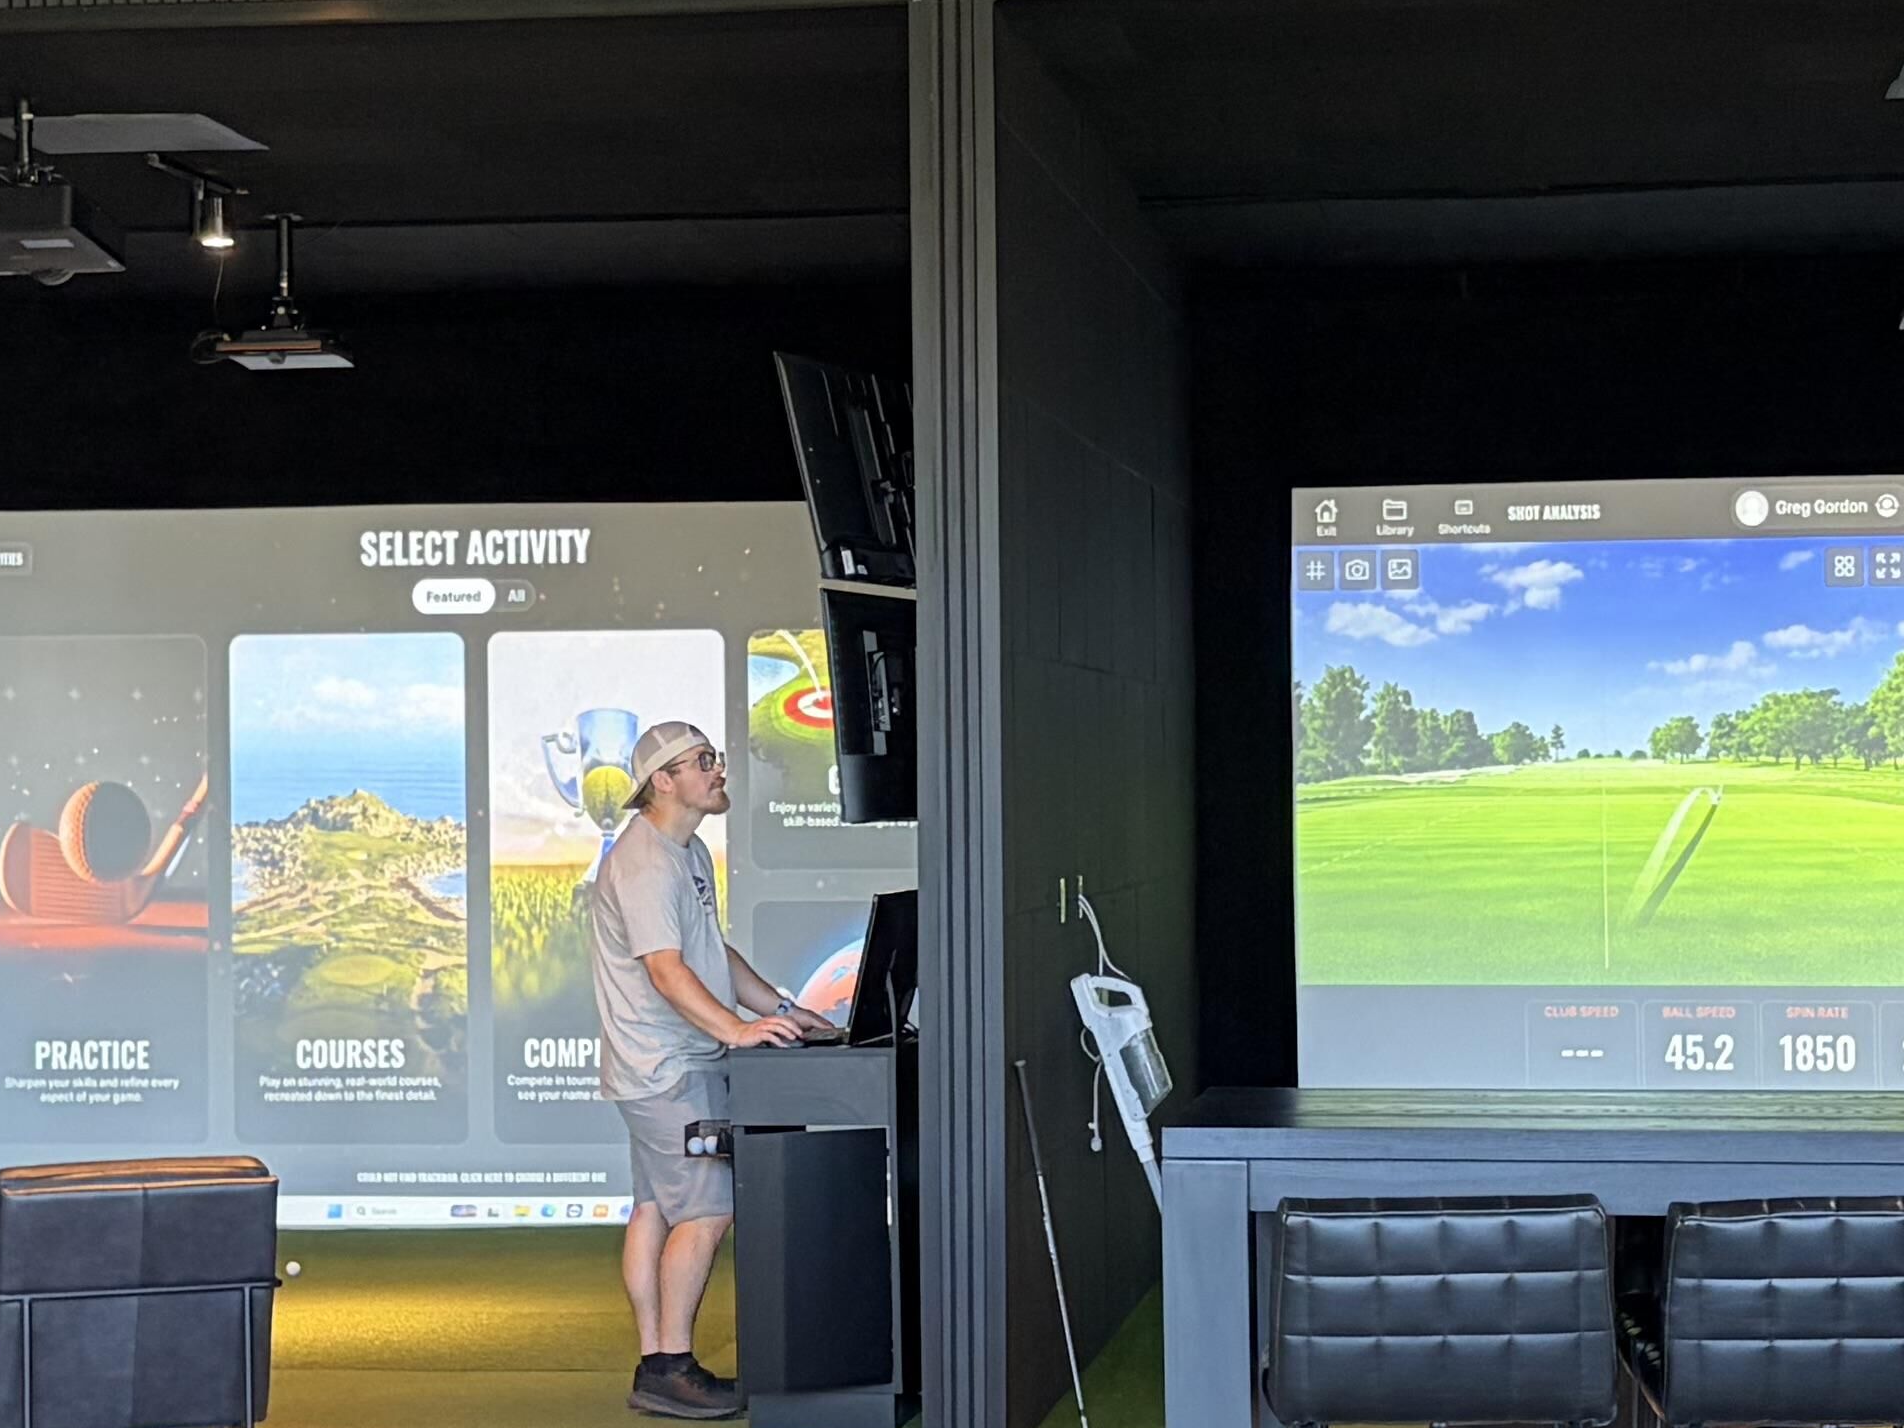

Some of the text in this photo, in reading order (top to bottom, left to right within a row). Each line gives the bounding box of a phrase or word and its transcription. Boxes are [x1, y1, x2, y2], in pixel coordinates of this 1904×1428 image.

[1507, 503, 1600, 522] SHOT ANALYSIS
[1775, 498, 1869, 518] Greg Gordon
[1316, 525, 1337, 537] Exit
[1376, 523, 1415, 537] Library
[1438, 523, 1491, 535] Shortcuts
[360, 528, 591, 567] SELECT ACTIVITY
[426, 590, 482, 603] Featured
[507, 589, 526, 603] All
[768, 801, 798, 815] Enjoy
[807, 801, 841, 815] variety
[1544, 1006, 1619, 1018] CLUB SPEED
[1662, 1006, 1736, 1019] BALL SPEED
[1785, 1006, 1848, 1019] SPIN RATE
[35, 1039, 151, 1070] PRACTICE
[296, 1038, 406, 1069] COURSES
[1664, 1034, 1735, 1072] 45.2
[1779, 1034, 1856, 1072] 1850
[48, 1078, 71, 1090] your
[151, 1078, 180, 1090] every
[259, 1075, 281, 1089] Play
[282, 1077, 296, 1087] on
[507, 1074, 601, 1088] Compete in tourna
[88, 1093, 111, 1104] your
[263, 1089, 437, 1102] recreated down to the finest detail.
[517, 1090, 537, 1101] see
[538, 1091, 561, 1103] your
[562, 1091, 591, 1101] name
